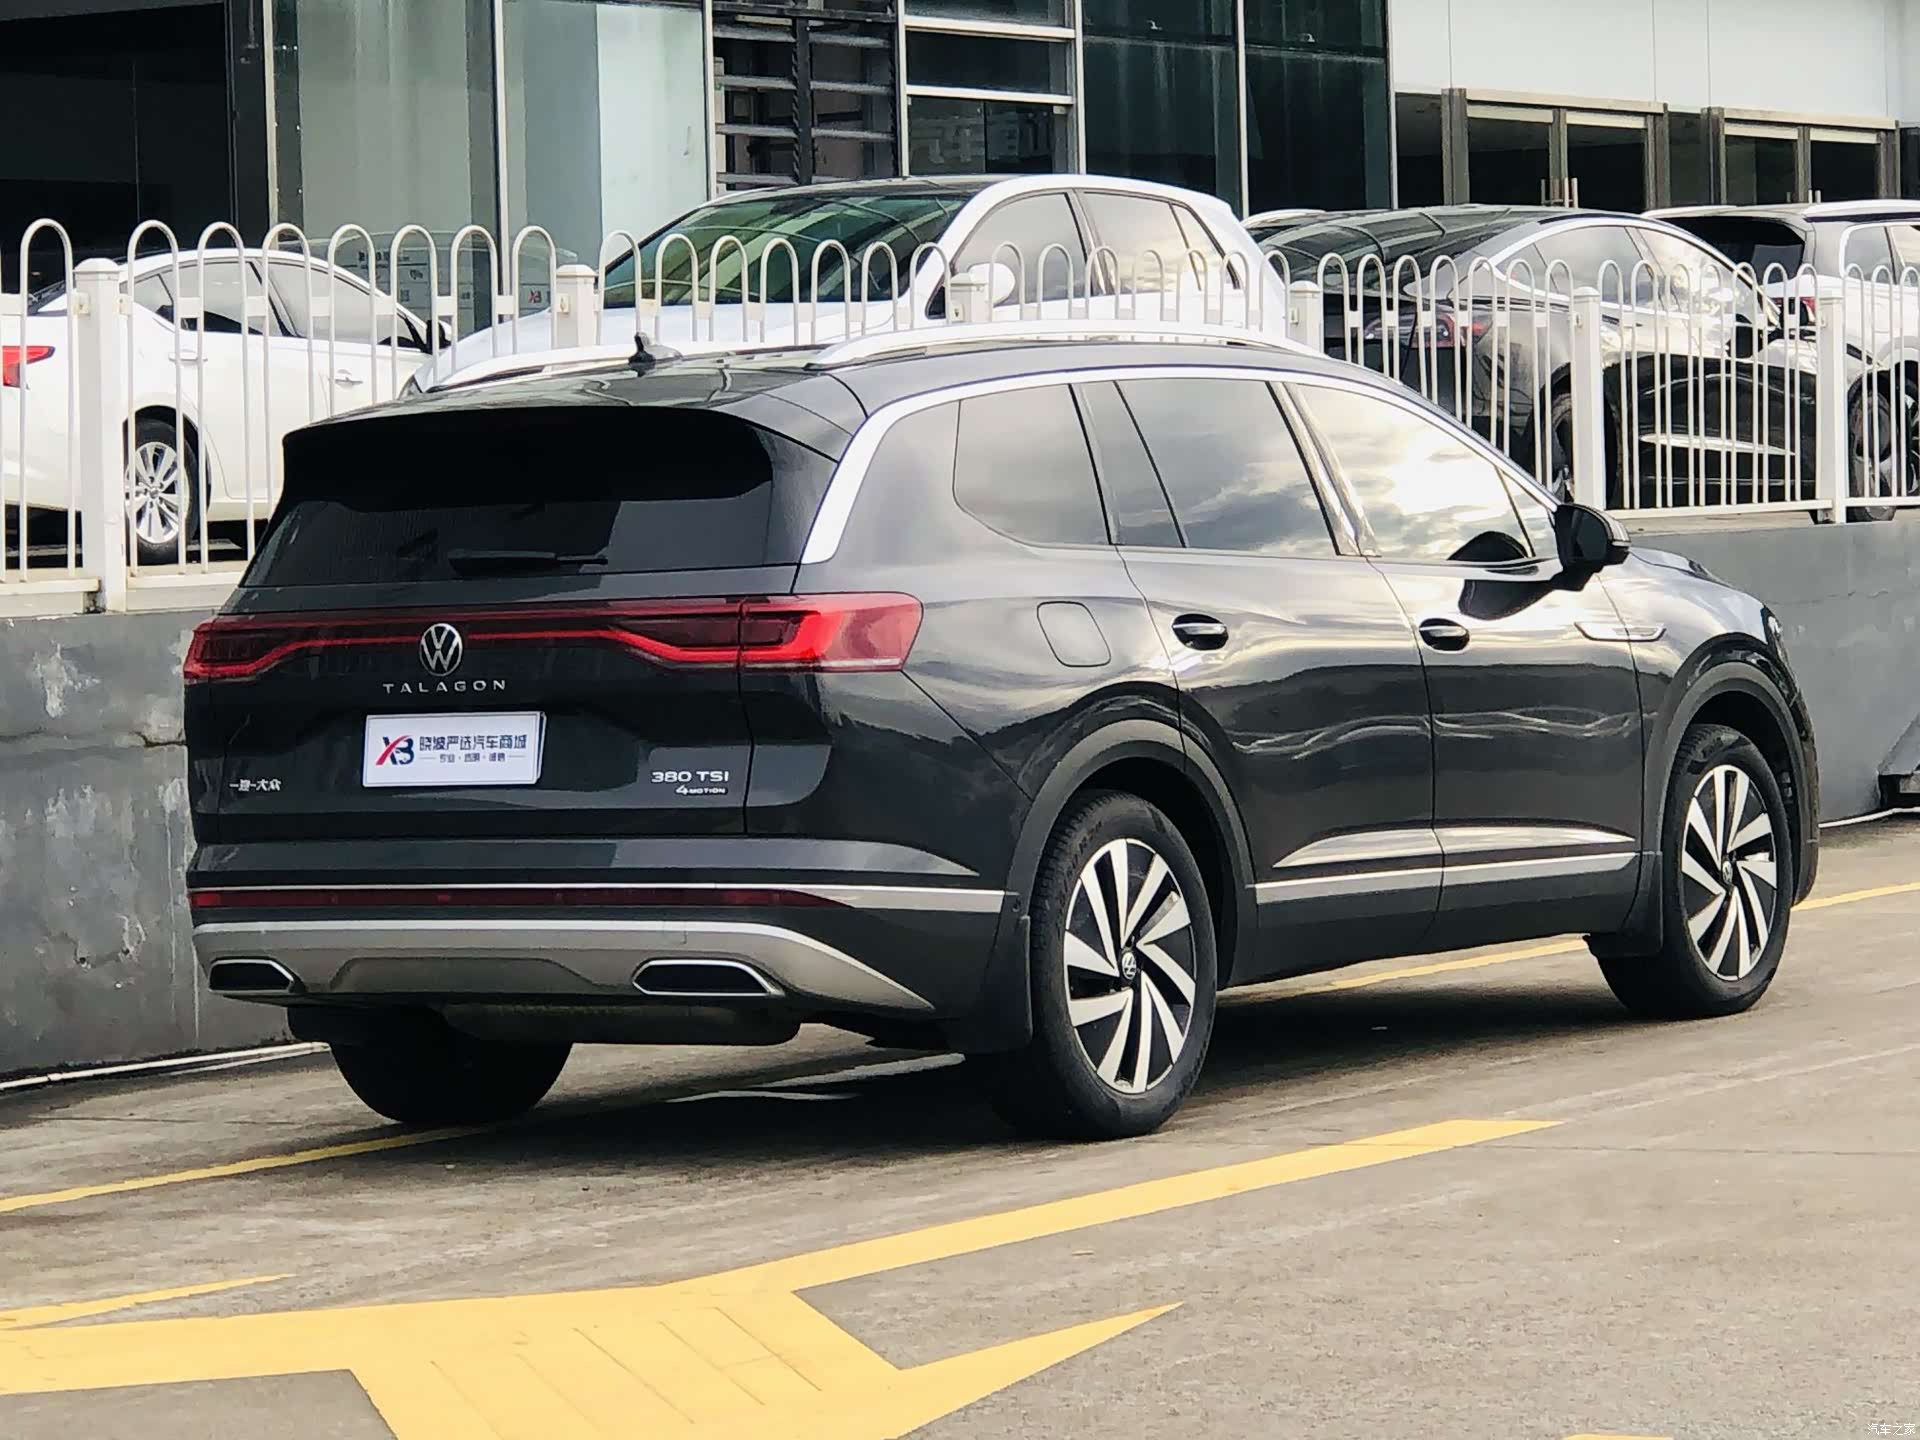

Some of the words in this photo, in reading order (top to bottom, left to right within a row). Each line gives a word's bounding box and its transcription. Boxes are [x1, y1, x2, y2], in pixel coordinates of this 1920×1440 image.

[382, 679, 506, 694] TALAGON
[651, 771, 692, 782] 380
[696, 771, 729, 782] TSI
